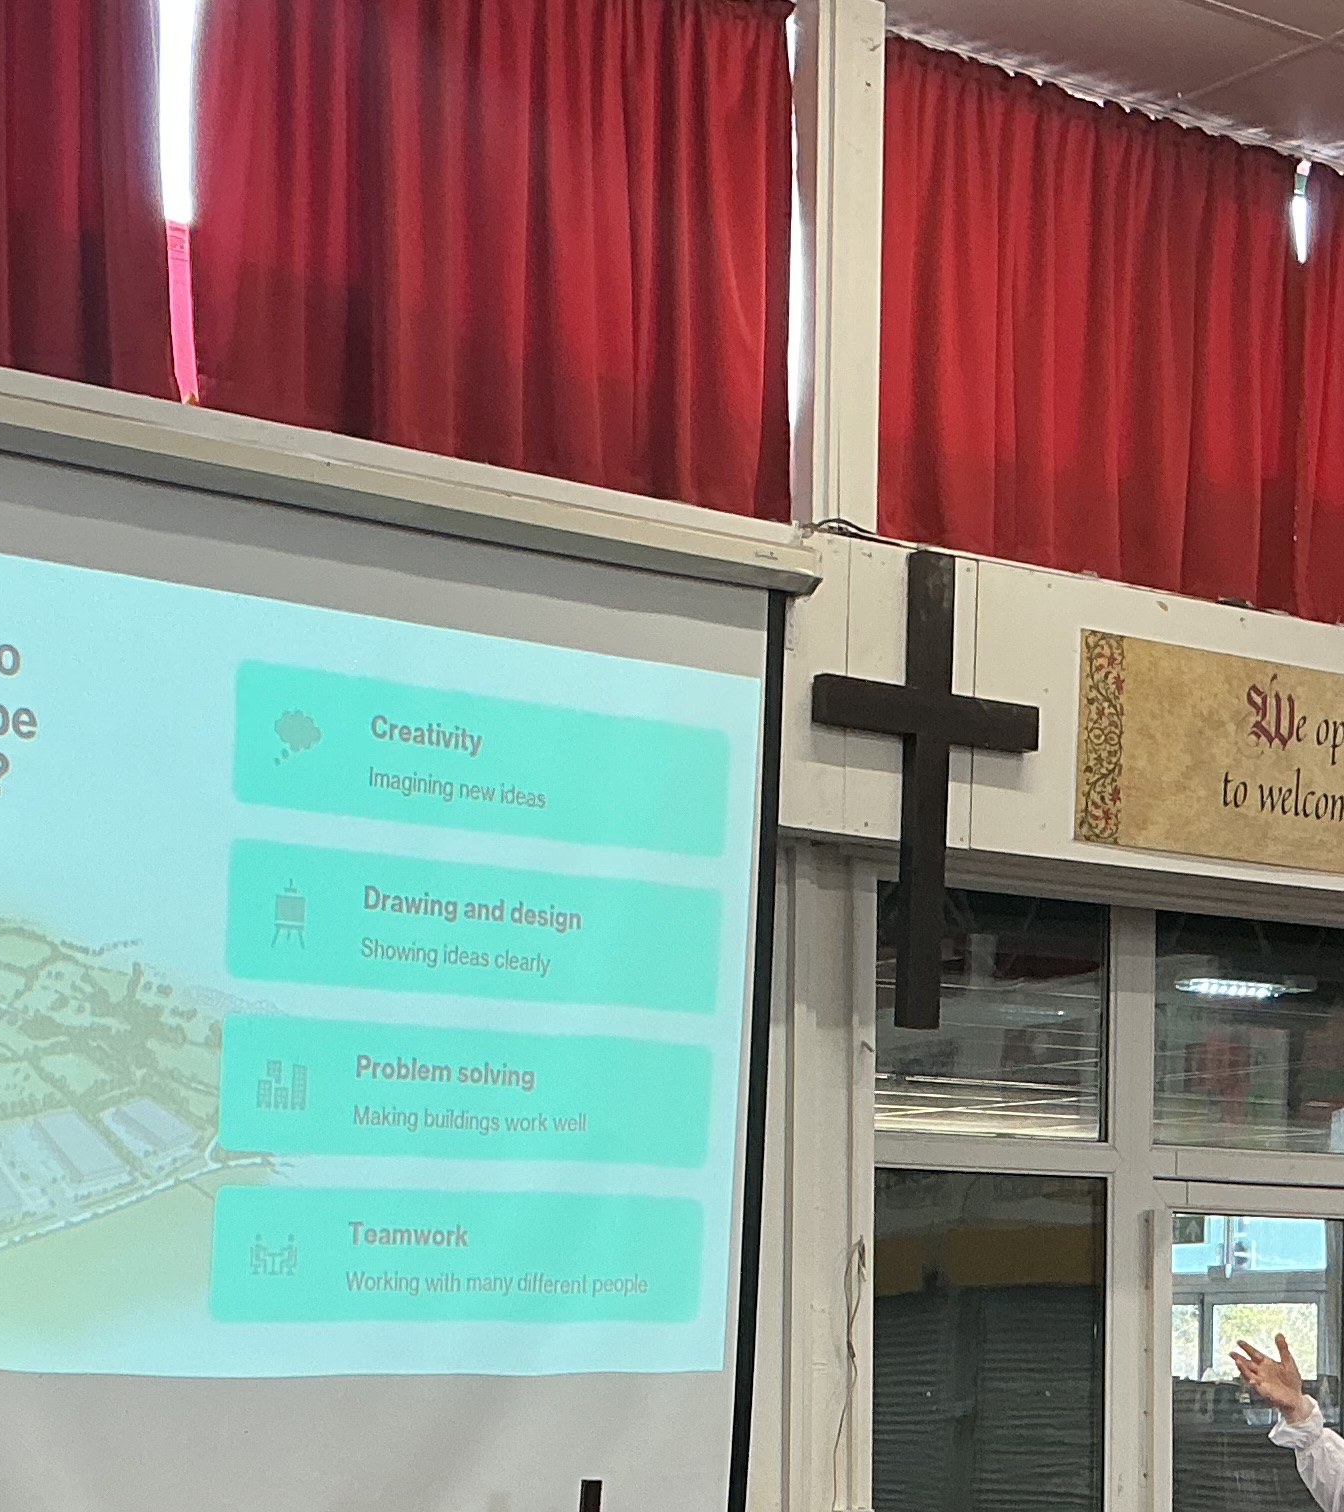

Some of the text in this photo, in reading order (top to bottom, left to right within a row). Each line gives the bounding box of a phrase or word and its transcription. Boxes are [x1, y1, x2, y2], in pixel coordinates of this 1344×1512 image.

[1246, 673, 1307, 750] We
[370, 714, 483, 758] Creativity
[368, 766, 547, 809] Imagining new ideas
[1222, 771, 1248, 810] to
[363, 885, 583, 935] Drawing and design
[360, 937, 551, 978] Showing ideas clearly
[356, 1055, 536, 1093] Problem solving
[352, 1105, 587, 1137] Making buildings work well
[348, 1220, 470, 1248] Teamwork
[346, 1271, 649, 1298] Working with many different people
